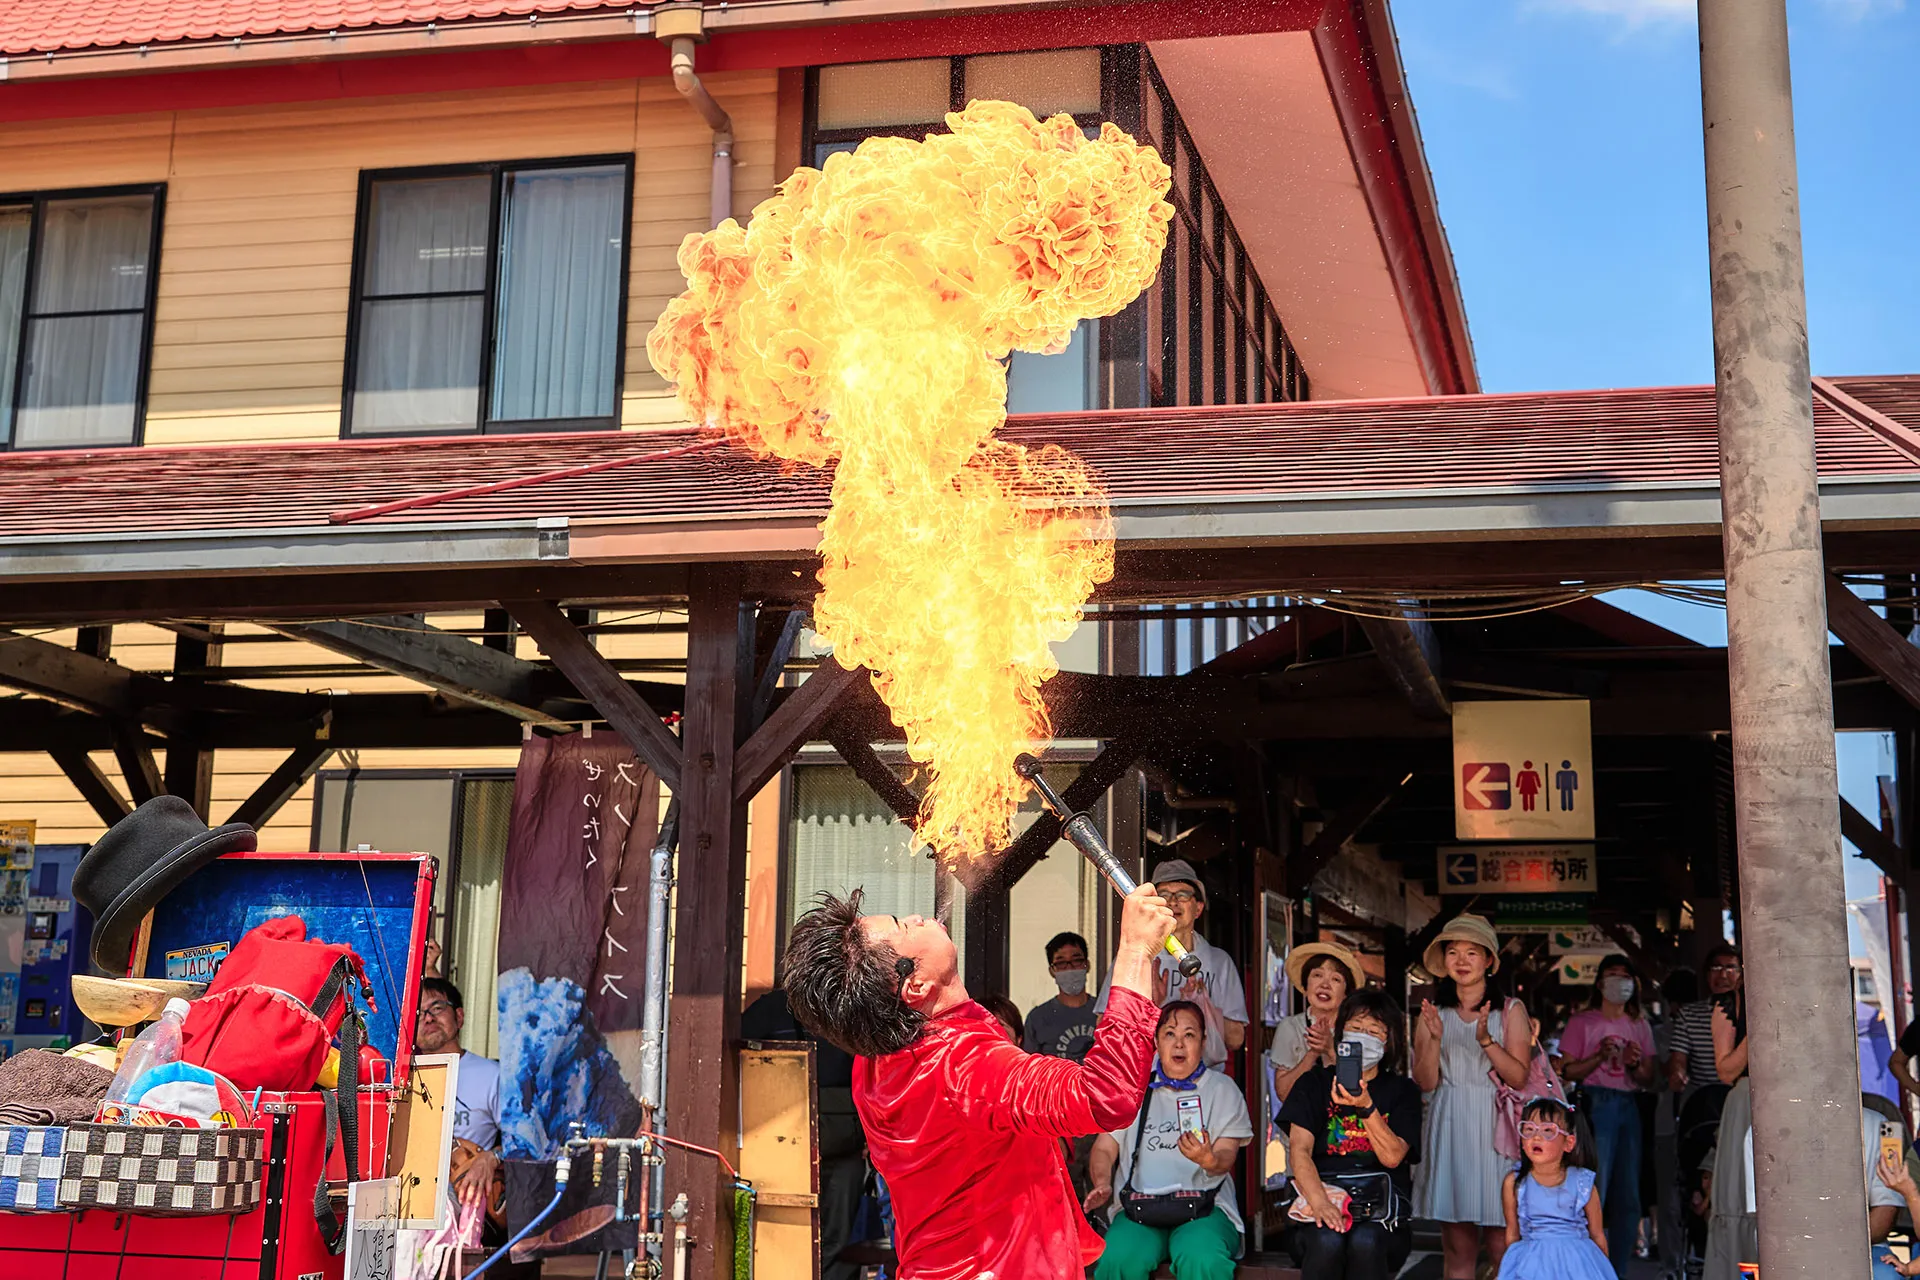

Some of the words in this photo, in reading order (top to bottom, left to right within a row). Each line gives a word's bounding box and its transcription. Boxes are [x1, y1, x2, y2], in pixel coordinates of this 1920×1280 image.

[1481, 857, 1588, 883] 総合案内所
[183, 948, 212, 958] NEVADA
